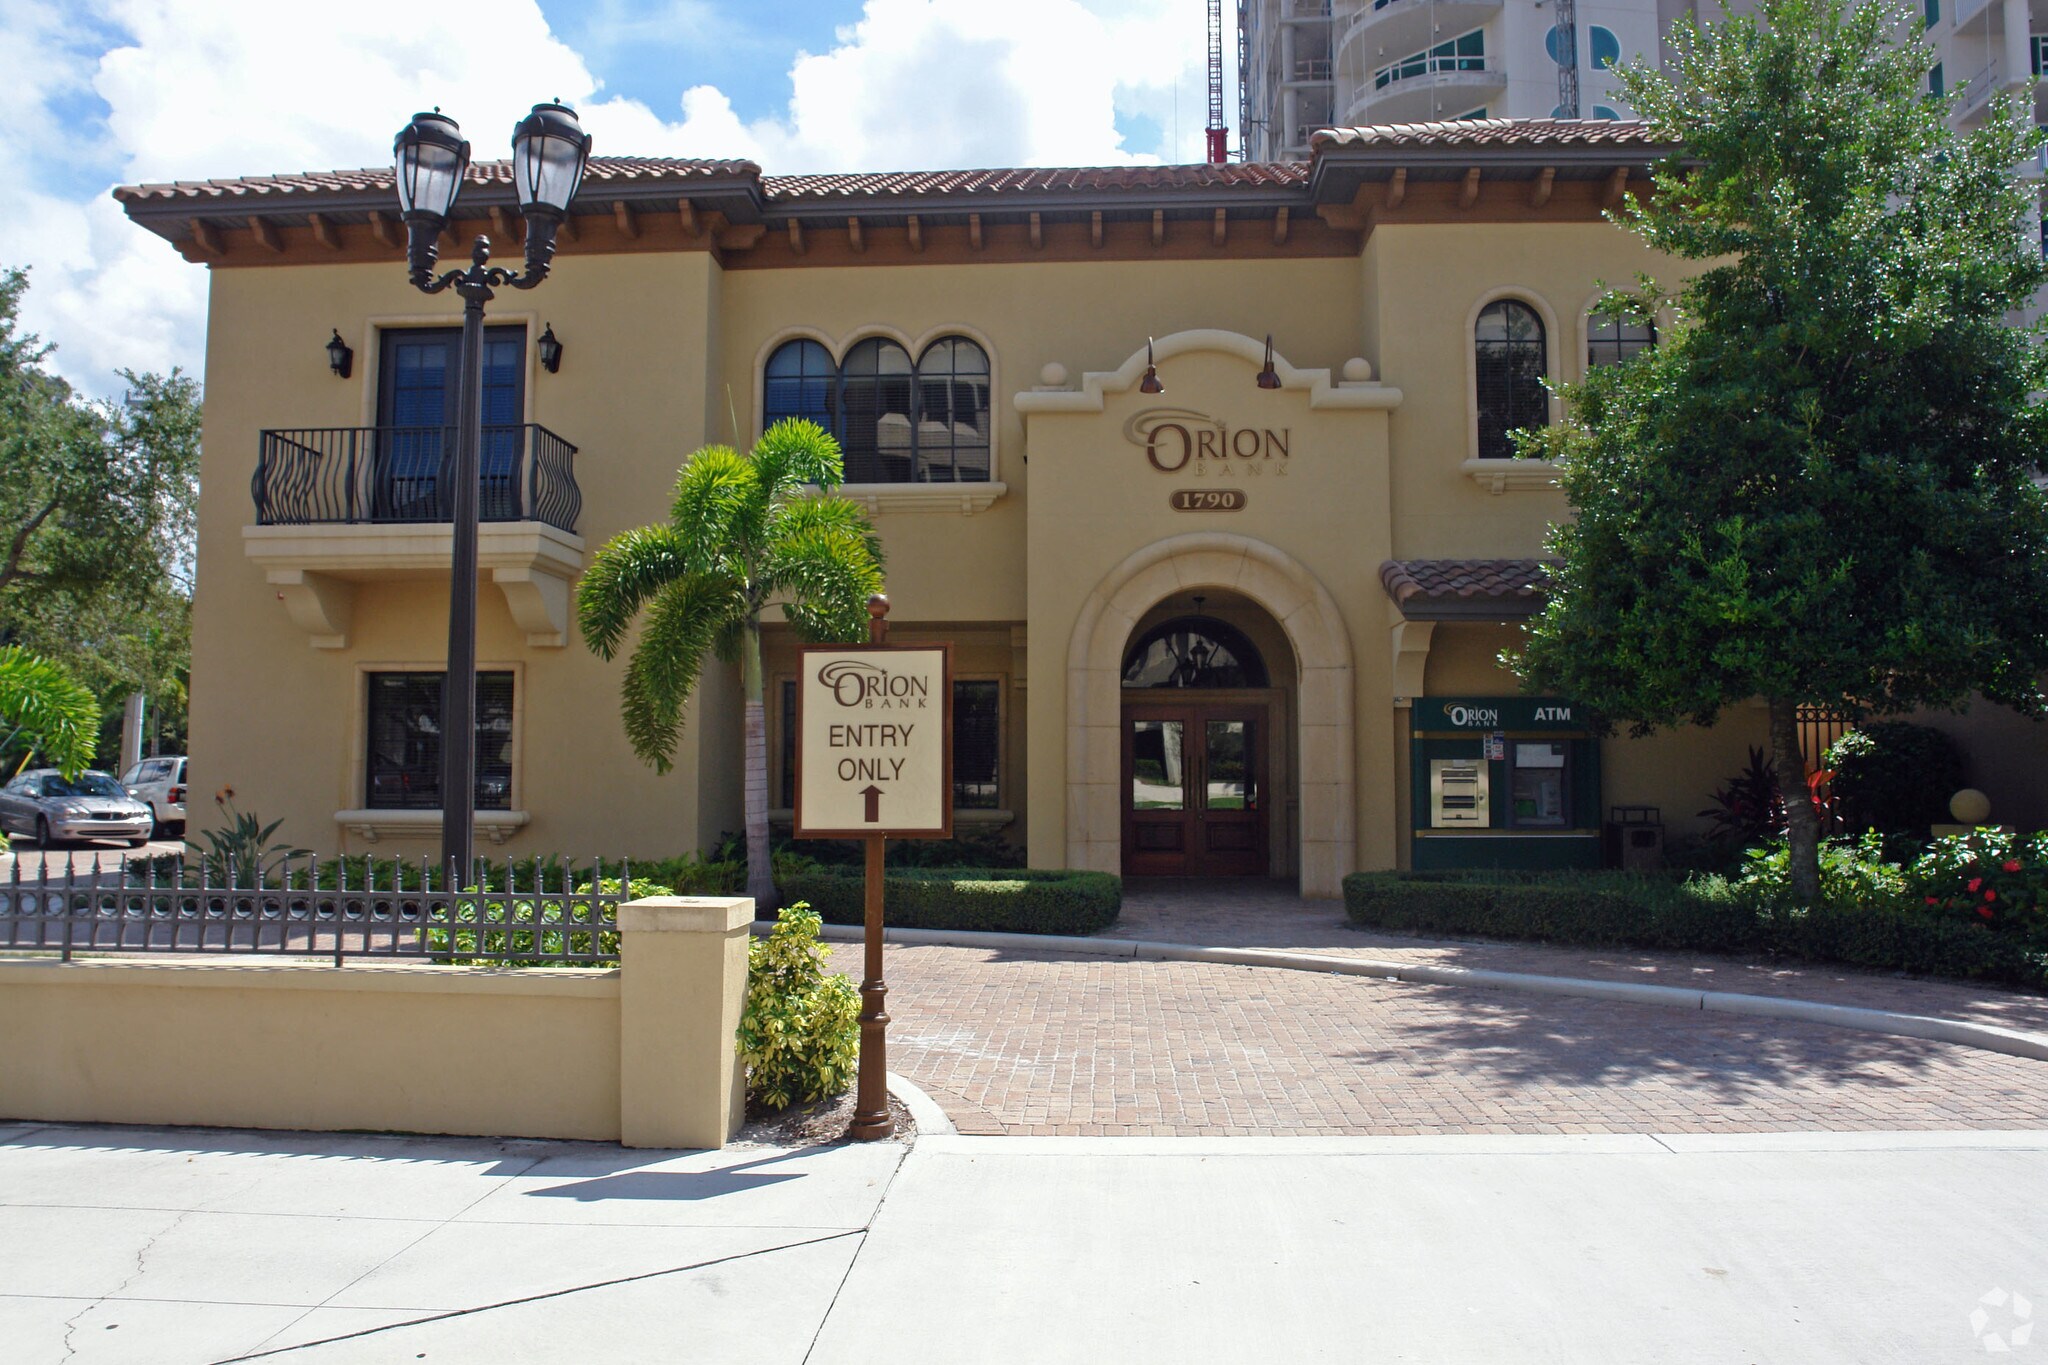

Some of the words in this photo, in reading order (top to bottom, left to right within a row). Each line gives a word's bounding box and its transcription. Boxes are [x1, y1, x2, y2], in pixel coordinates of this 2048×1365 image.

[1147, 423, 1291, 472] ORION
[1194, 461, 1289, 476] BANK
[1182, 492, 1235, 508] 1790
[833, 672, 928, 707] ORION
[865, 699, 927, 709] BANK
[1534, 707, 1571, 721] ATM
[1451, 706, 1498, 726] ORION
[829, 724, 914, 747] ENTRY
[838, 757, 906, 781] ONLY
